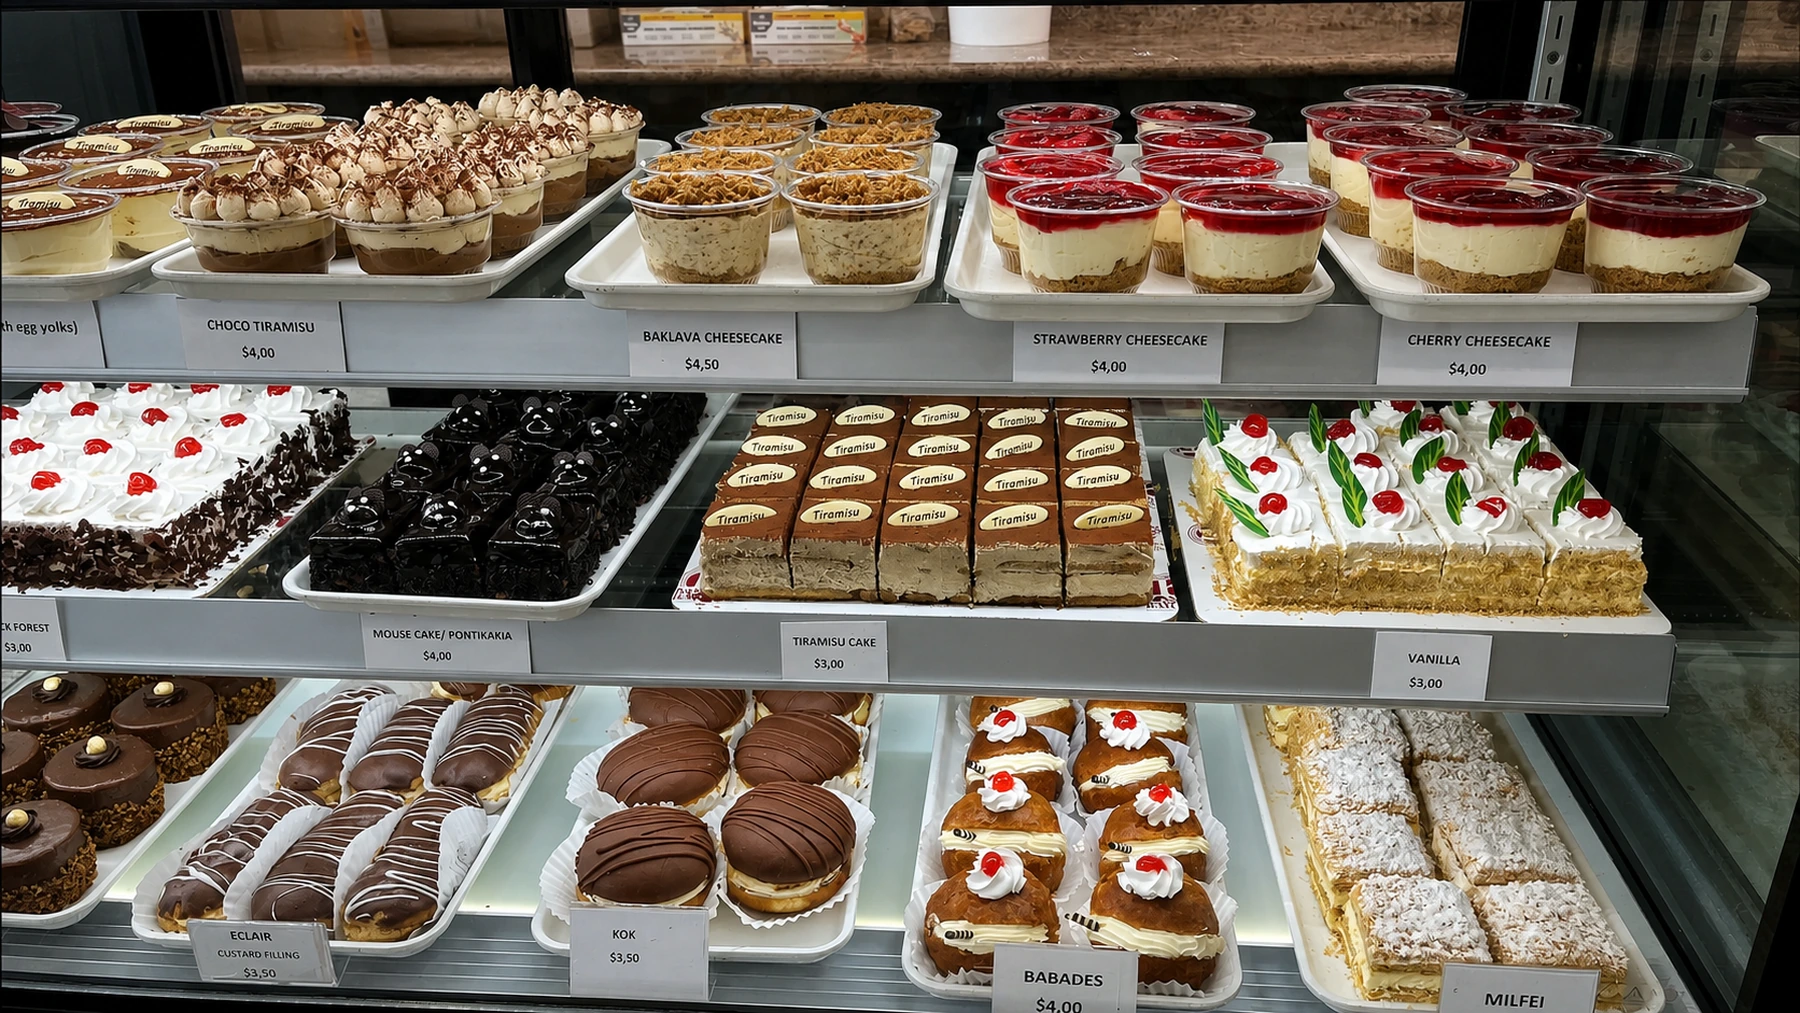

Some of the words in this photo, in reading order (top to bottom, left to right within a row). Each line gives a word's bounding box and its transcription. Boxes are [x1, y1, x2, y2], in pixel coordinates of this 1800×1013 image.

[16, 323, 38, 335] egg
[40, 320, 78, 336] yolks)
[207, 319, 250, 332] CHOCO
[253, 320, 315, 333] TIRAMISU
[643, 331, 701, 343] BAKLAVA
[704, 332, 783, 344] CHEESECAKE
[1033, 333, 1122, 345] STRAWBERRY
[1126, 334, 1208, 346] CHEESECAKE
[1407, 334, 1462, 346] CHERRY
[1465, 335, 1551, 348] CHEESECAKE
[242, 346, 275, 360] $4,00
[685, 357, 720, 372] $4,50
[1091, 359, 1127, 374] $4,00
[1449, 361, 1487, 377] $4,00
[766, 411, 807, 423] Tiramisu
[844, 412, 885, 424] Tiramisu
[921, 410, 960, 423] Tiramisu
[998, 414, 1037, 427] Tiramisu
[1076, 417, 1117, 428] Tiramisu
[751, 441, 794, 452] Tiramisu
[834, 441, 876, 455] Tiramisu
[917, 442, 959, 454] Tiramisu
[995, 440, 1033, 458] Tiramisu
[1076, 443, 1115, 459] Tiramisu
[738, 471, 784, 485] Tiramisu
[820, 472, 865, 486] Tiramisu
[910, 471, 954, 486] Tiramisu
[995, 476, 1038, 490] Tiramisu
[1076, 472, 1120, 486] Tiramisu
[717, 511, 765, 525] Tiramisu
[812, 507, 860, 521] Tiramisu
[900, 509, 946, 524] Tiramisu
[991, 511, 1037, 527] Tiramisu
[1086, 510, 1133, 526] Tiramisu
[13, 622, 50, 633] FOREST
[373, 629, 411, 639] MOUSE
[414, 630, 446, 641] CAKE/
[449, 630, 513, 641] PONTIKAKIA
[793, 636, 846, 647] TIRAMISU
[848, 637, 877, 648] CAKE
[5, 642, 31, 653] $3,00
[423, 650, 452, 662] $4,00
[1408, 653, 1461, 665] VANILLA
[814, 658, 844, 670] $3,00
[1409, 677, 1443, 690] $3,00
[230, 931, 273, 942] ECLAIR
[612, 929, 636, 940] KOK
[217, 949, 262, 959] CUSTARD
[264, 951, 300, 960] FILLING
[610, 952, 640, 964] $3,50
[243, 967, 277, 979] $3,50
[1024, 970, 1104, 987] BABADES
[1036, 997, 1083, 1013] $4,00
[1484, 993, 1545, 1009] MILFEI
